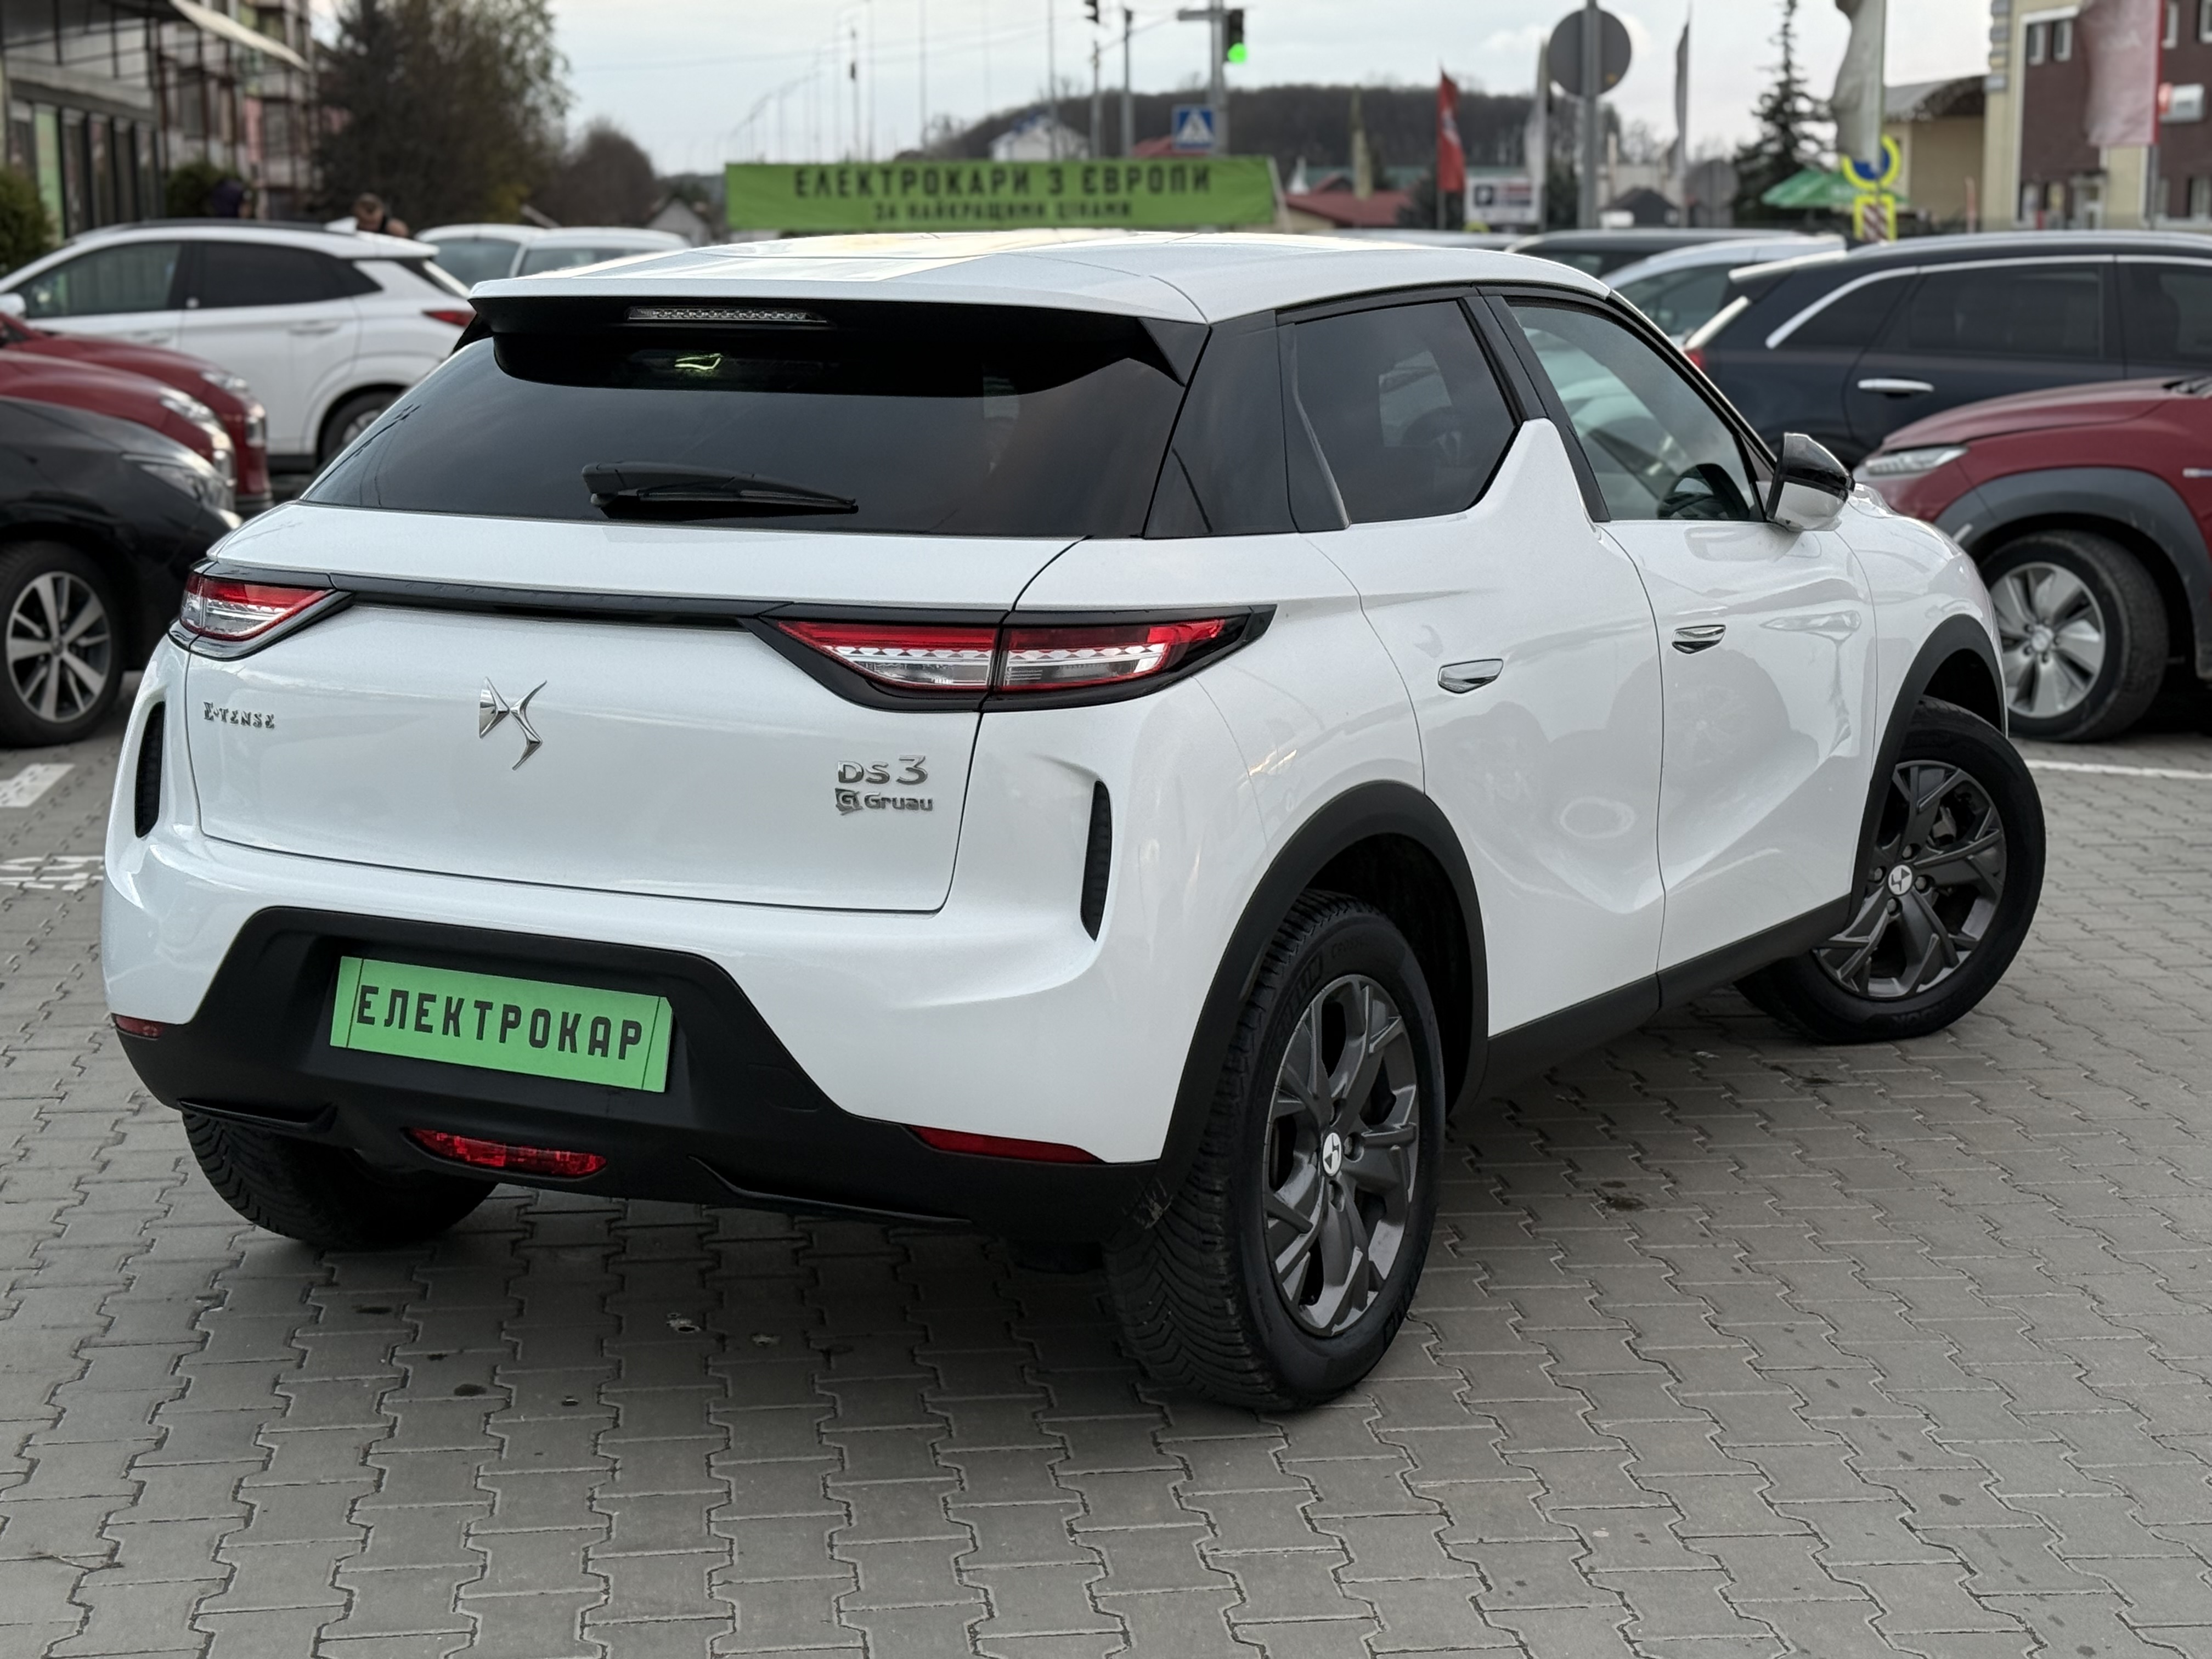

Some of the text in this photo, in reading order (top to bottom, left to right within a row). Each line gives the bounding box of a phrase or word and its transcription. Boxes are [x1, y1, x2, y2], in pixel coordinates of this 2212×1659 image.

[794, 164, 1210, 198] ЕЛЕКТРОКАРИ З ЄВРОПИ
[864, 792, 933, 812] Gruau
[357, 985, 642, 1060] ЕЛЕКТРОКАР
